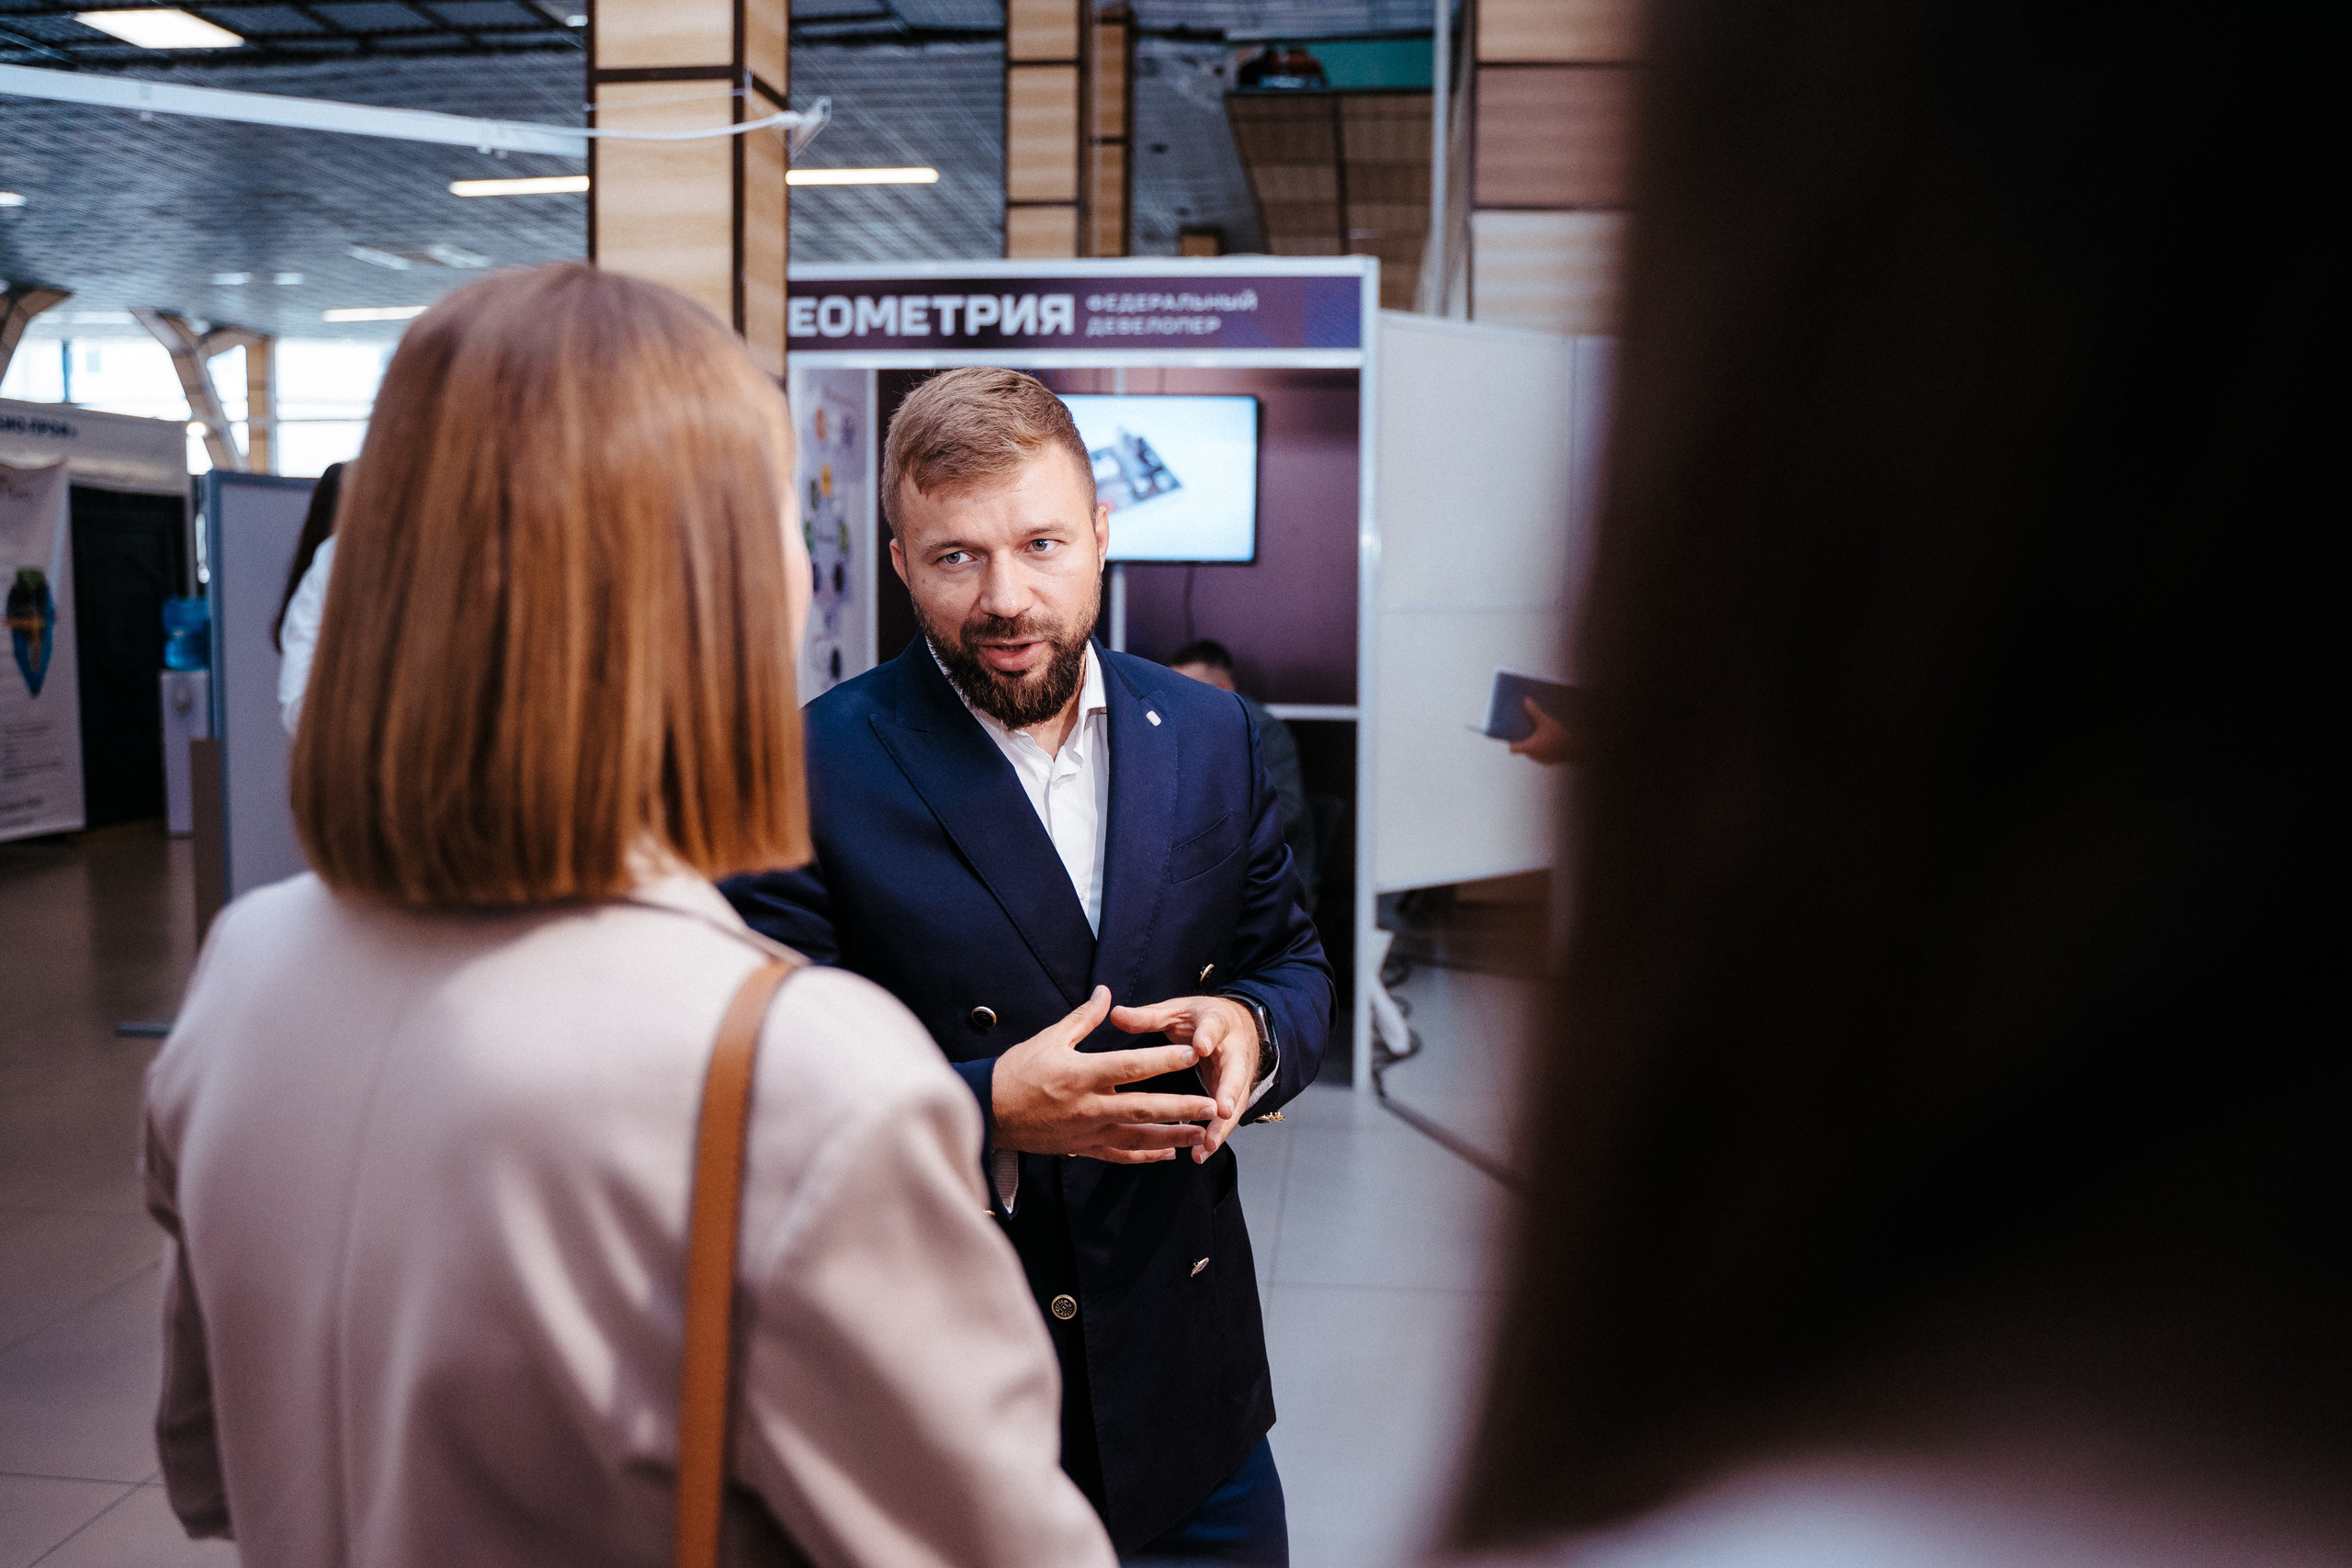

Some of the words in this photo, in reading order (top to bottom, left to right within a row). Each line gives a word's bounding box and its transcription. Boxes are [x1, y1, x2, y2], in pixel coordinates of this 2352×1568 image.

[1086, 289, 1258, 313] ФЕДЕРАЛЬНЫЙ
[787, 294, 1075, 336] ЕОМЕТРИЯ
[1086, 316, 1221, 337] ДЕВЕЛОПЕР
